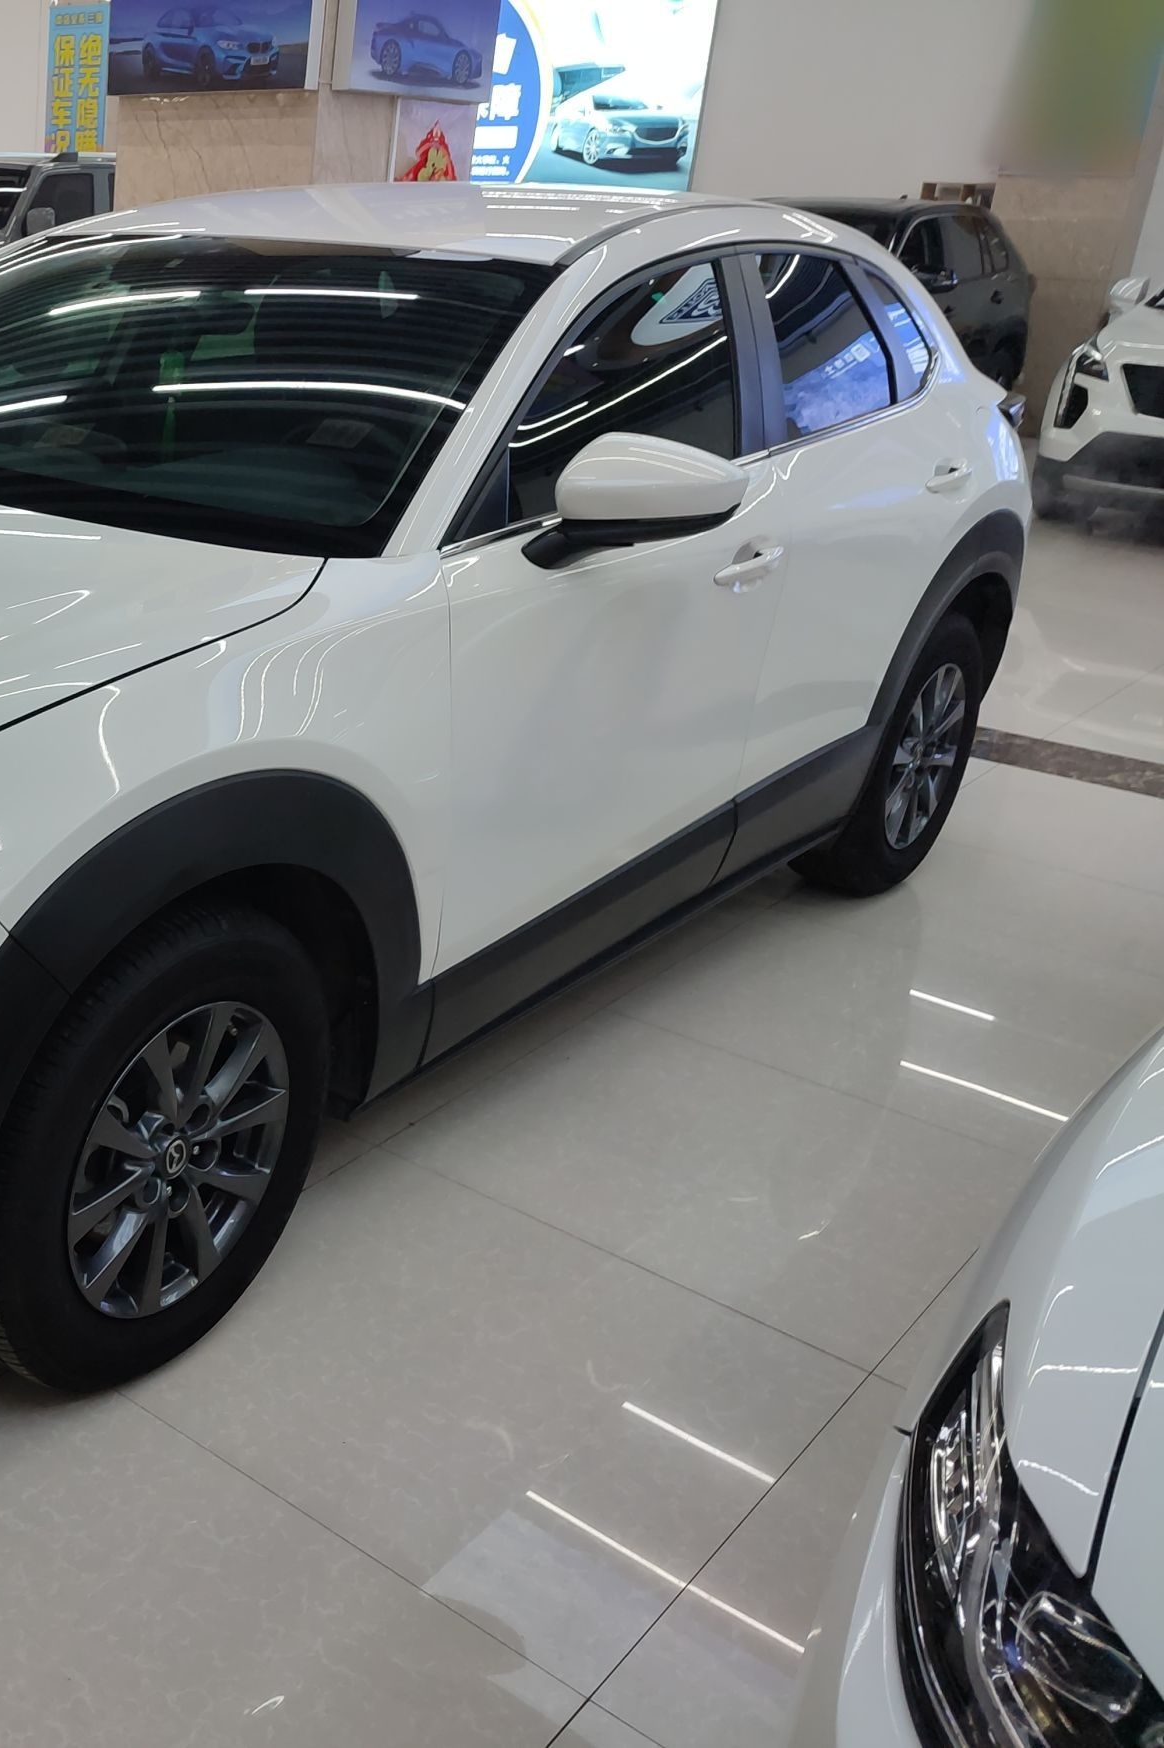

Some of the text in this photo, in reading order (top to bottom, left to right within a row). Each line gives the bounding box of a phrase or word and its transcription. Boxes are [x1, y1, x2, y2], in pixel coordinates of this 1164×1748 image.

[51, 35, 76, 152] 保证车况
[77, 34, 103, 152] 绝无隐瞒
